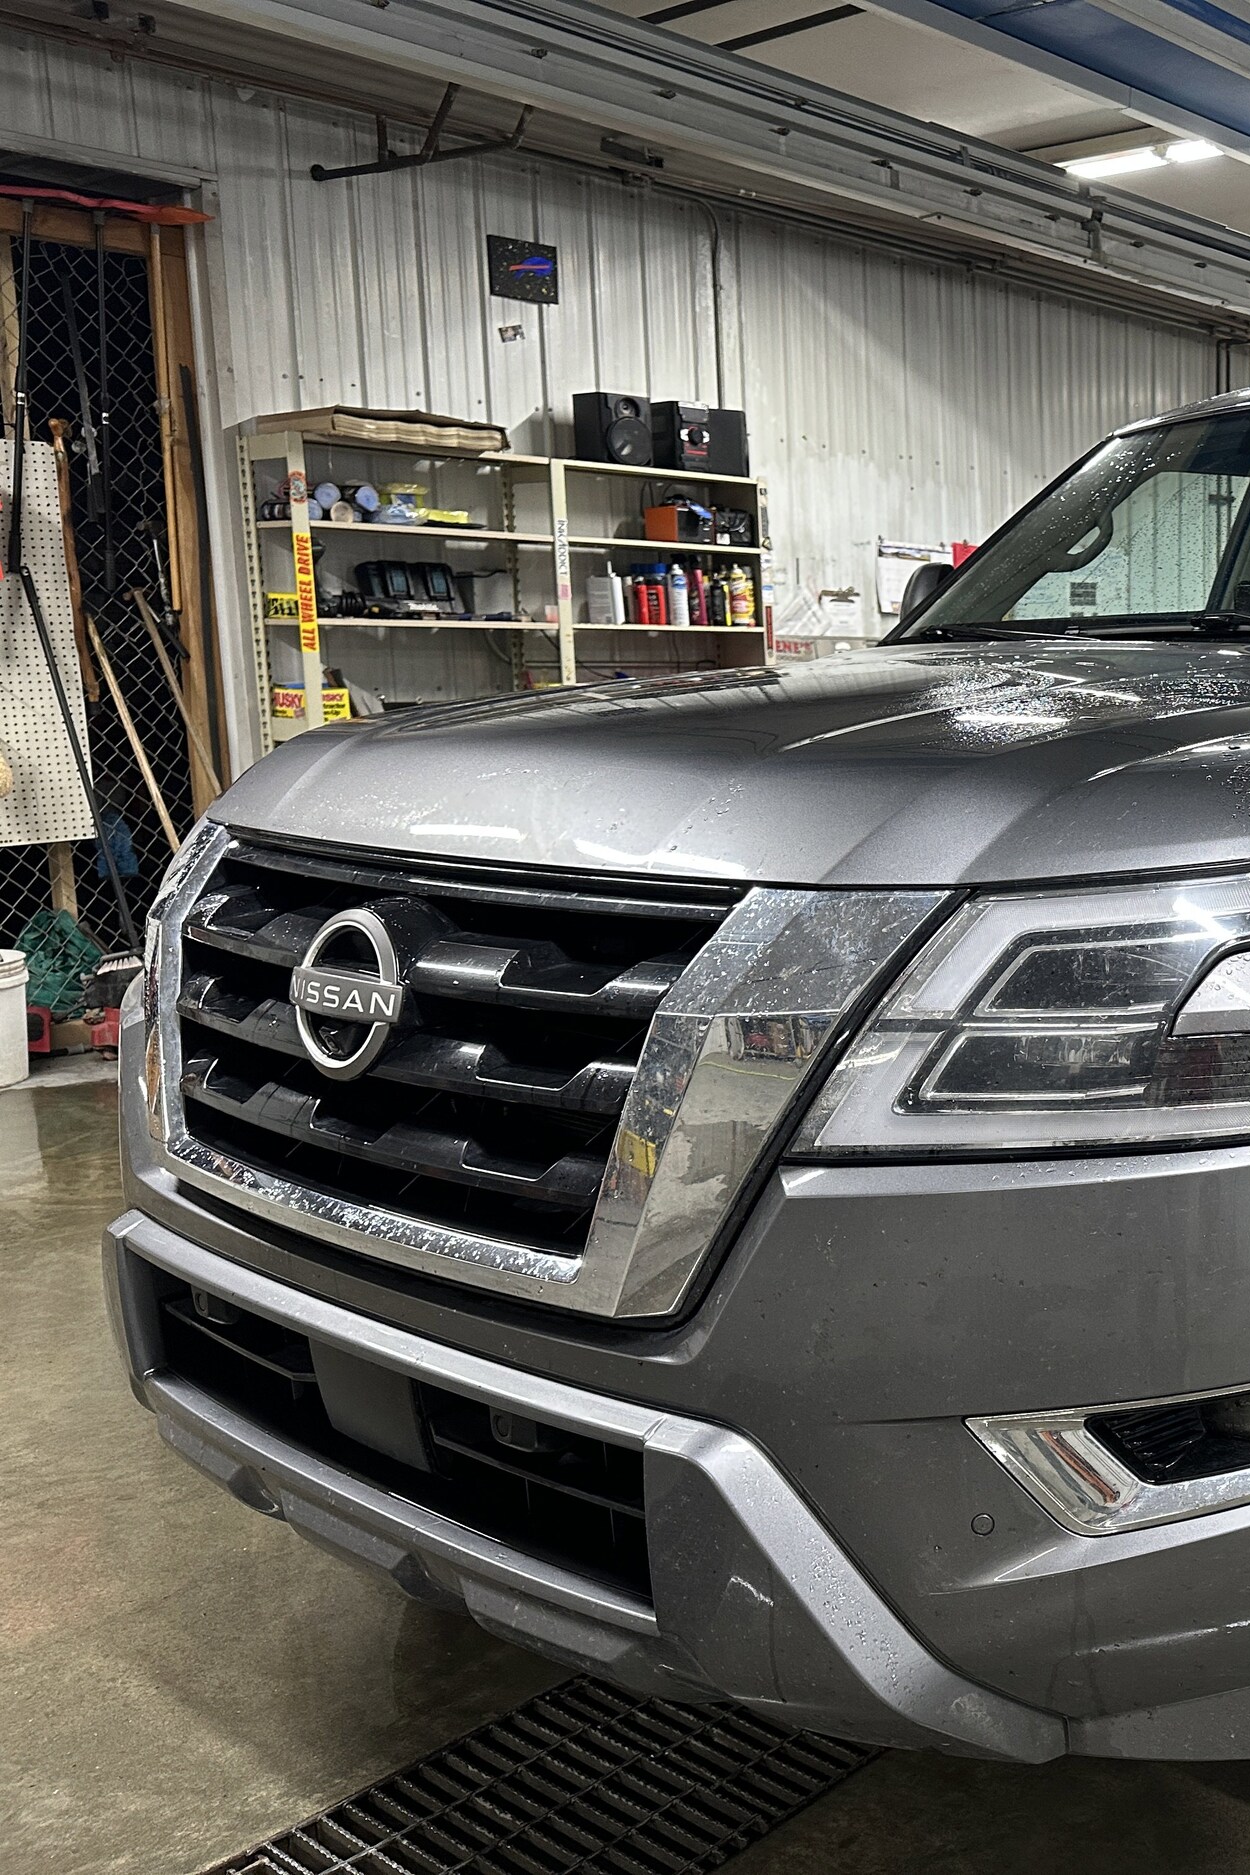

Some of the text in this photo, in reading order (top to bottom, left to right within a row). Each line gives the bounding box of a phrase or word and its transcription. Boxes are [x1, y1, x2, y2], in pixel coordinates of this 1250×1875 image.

[296, 534, 317, 651] ALL WHEEL DRIVE
[776, 639, 813, 655] ENE'S
[290, 974, 396, 1017] NISSAN
